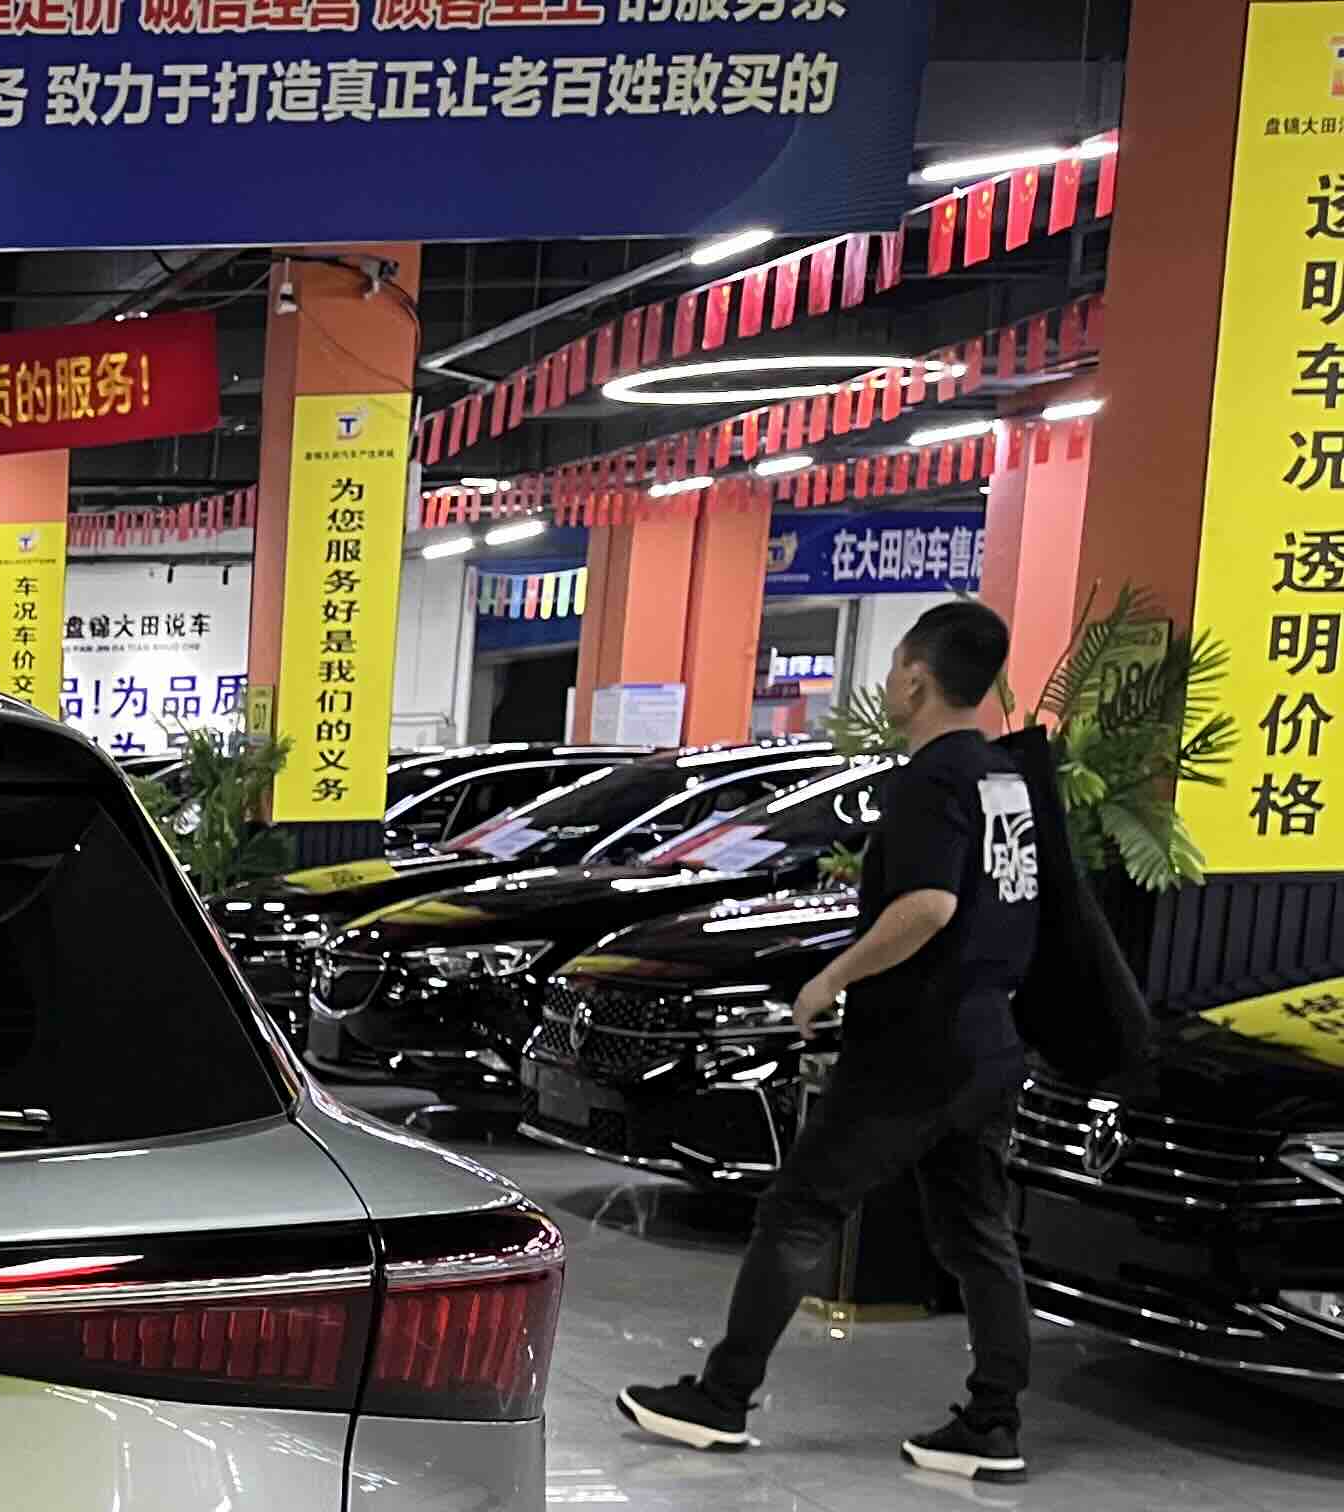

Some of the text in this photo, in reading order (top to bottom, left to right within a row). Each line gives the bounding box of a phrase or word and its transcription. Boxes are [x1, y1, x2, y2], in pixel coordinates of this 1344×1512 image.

[46, 53, 839, 126] 致力于打造真正让老百姓敢买的
[312, 477, 365, 803] 为您服务好是我们的义务
